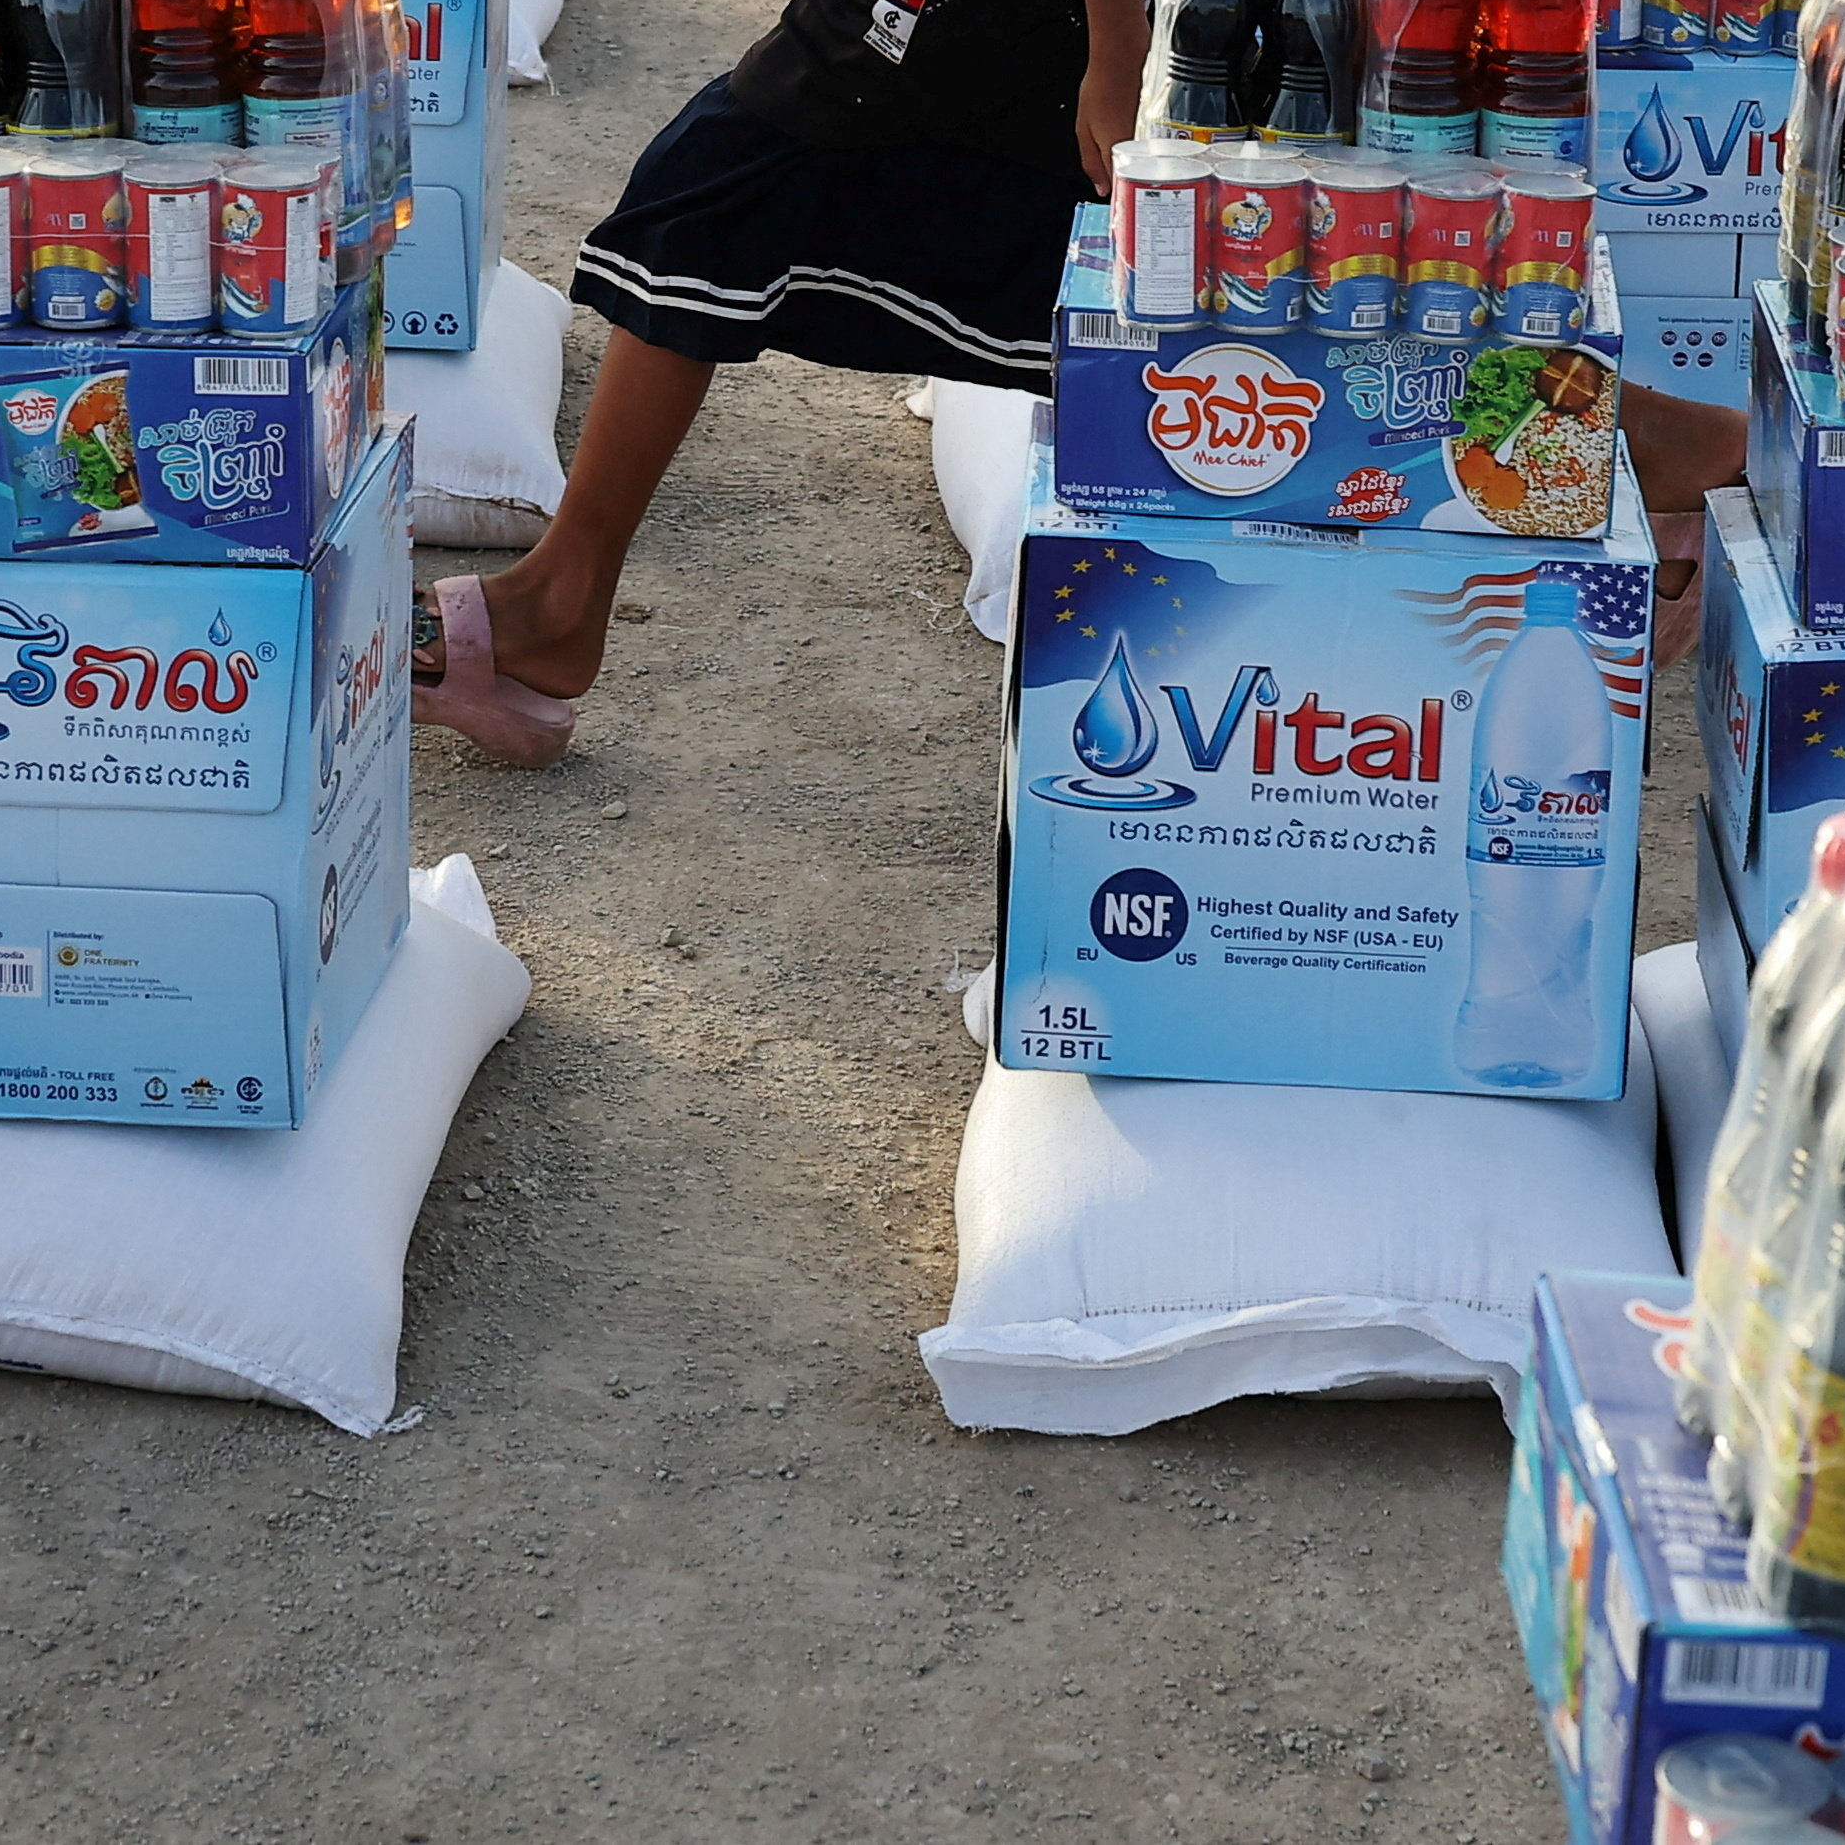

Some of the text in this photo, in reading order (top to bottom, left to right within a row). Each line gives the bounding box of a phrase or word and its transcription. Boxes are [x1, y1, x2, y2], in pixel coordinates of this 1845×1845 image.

[1384, 425, 1452, 444] Minced Pork
[1194, 451, 1223, 466] Mee
[1076, 498, 1106, 509] Weight
[1137, 501, 1176, 512] 24packs
[203, 510, 243, 527] Minced
[1160, 665, 1443, 782] Vital
[1251, 782, 1440, 811] Premium Water
[1491, 842, 1511, 856] NSF
[1103, 894, 1173, 938] NSF
[1196, 896, 1459, 929] Highest Quality and Safety
[1210, 923, 1444, 952] Certified by NSF (USA EU)
[1076, 947, 1099, 962] EU
[1175, 952, 1198, 968] US
[1223, 952, 1427, 975] Beverage Quality Certification
[1038, 1004, 1099, 1033] 1.5L
[1020, 1037, 1112, 1062] 12 BTL
[58, 1070, 85, 1081] TOLL
[87, 1071, 115, 1082] FREE
[46, 1084, 80, 1101] 200
[85, 1085, 118, 1103] 333
